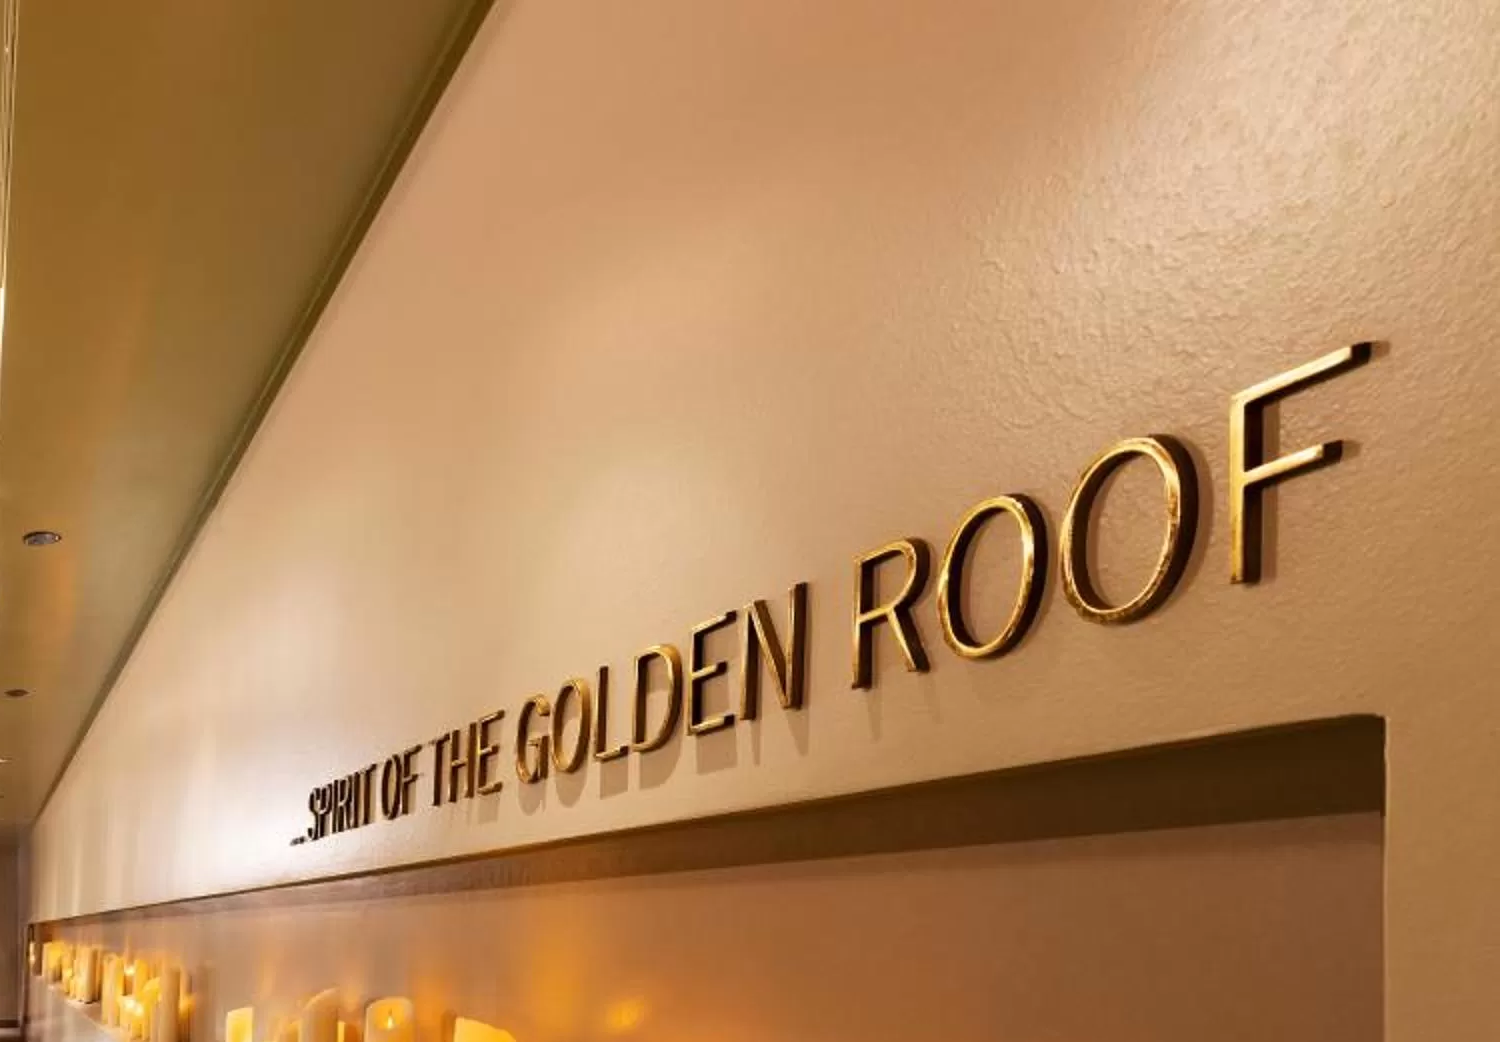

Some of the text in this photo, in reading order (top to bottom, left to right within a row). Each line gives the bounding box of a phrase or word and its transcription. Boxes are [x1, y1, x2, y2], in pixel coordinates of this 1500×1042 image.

[381, 744, 422, 820] OF
[429, 709, 505, 806] THE
[515, 582, 808, 784] GOLDEN
[851, 342, 1371, 690] ROOF
